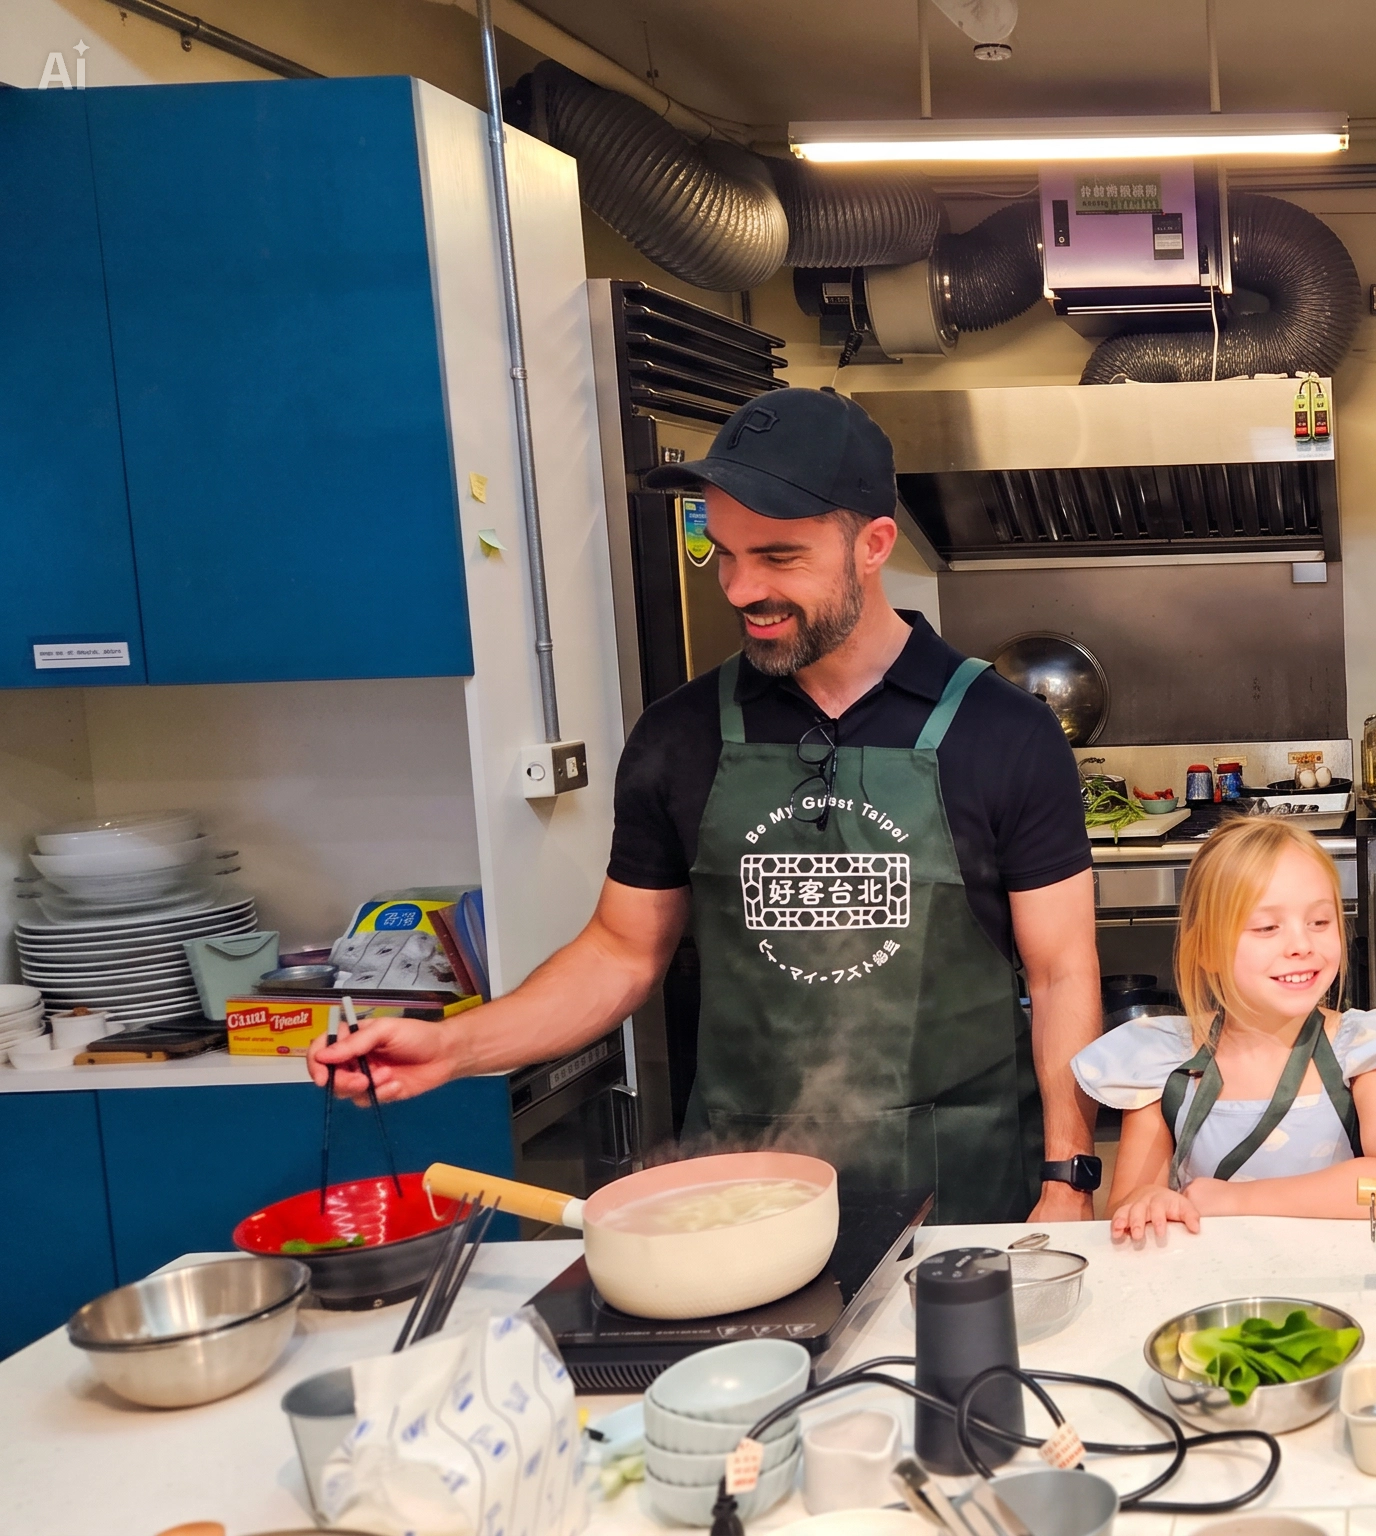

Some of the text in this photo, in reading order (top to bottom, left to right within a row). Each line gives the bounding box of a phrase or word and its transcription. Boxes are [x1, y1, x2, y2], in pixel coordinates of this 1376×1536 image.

[728, 406, 780, 450] P
[745, 824, 767, 844] Be
[769, 806, 793, 824] My
[862, 803, 909, 843] Taipei
[768, 878, 884, 905] 好客台北
